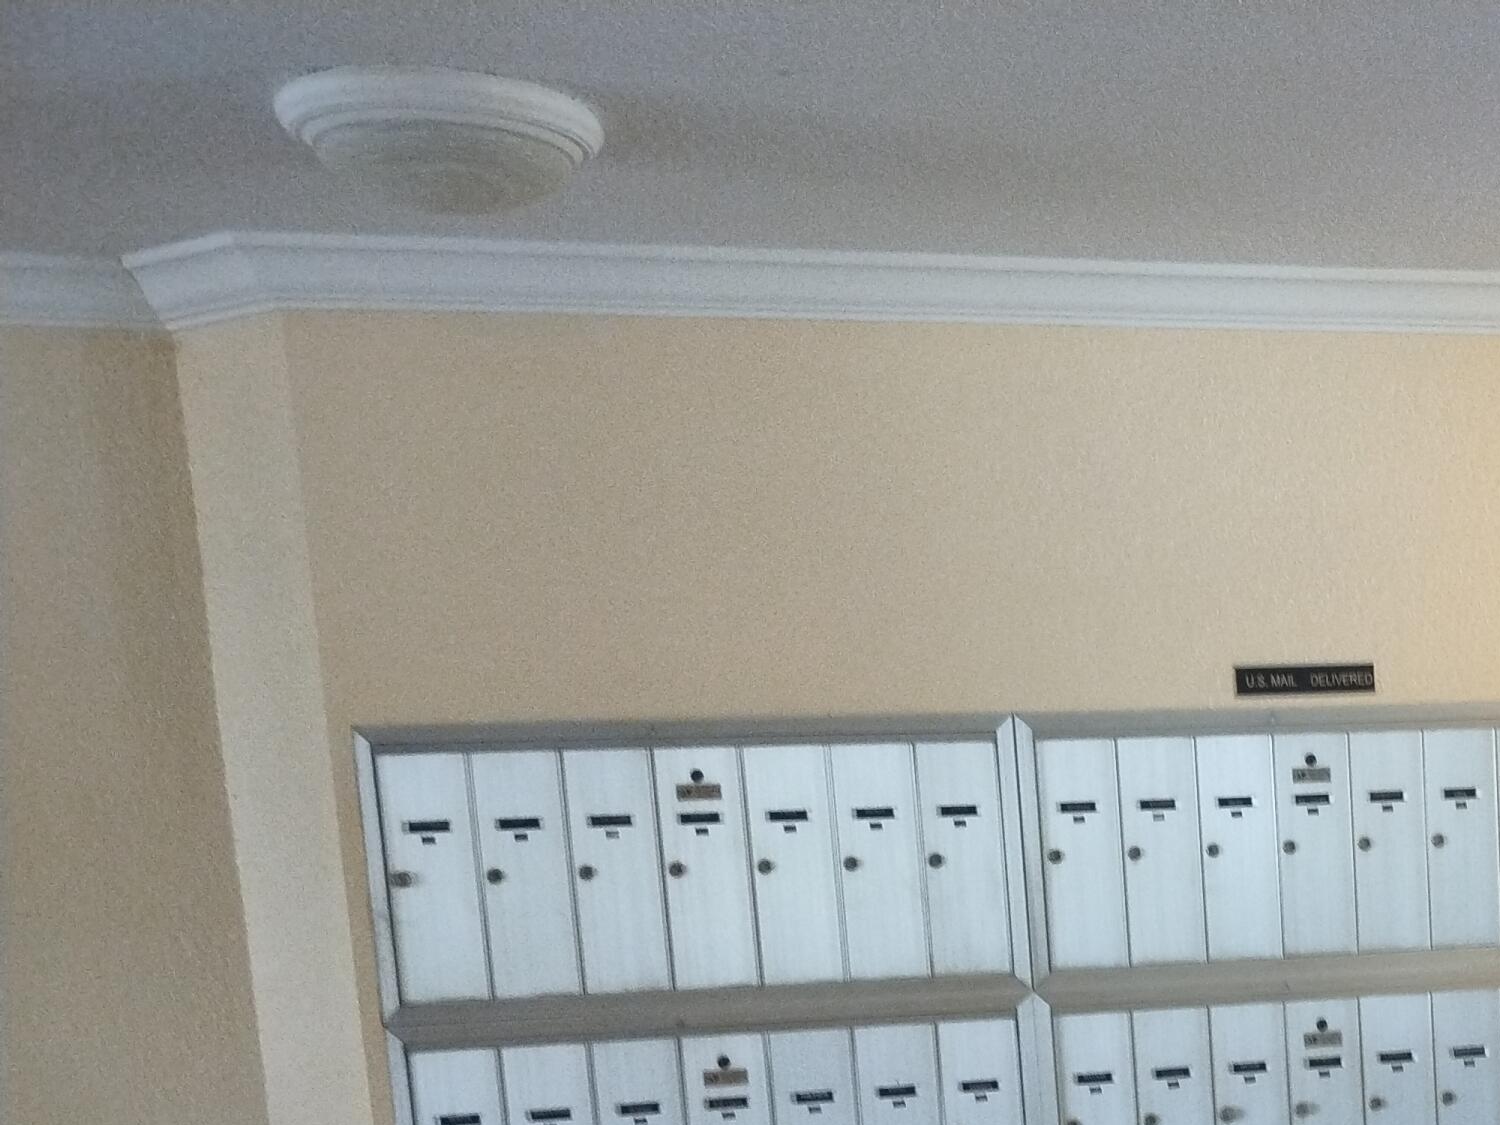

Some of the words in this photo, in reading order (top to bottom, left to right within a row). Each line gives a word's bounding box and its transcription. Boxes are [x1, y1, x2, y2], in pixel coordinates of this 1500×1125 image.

[1245, 673, 1268, 688] U.S.
[1270, 673, 1297, 688] MAIL
[1310, 671, 1373, 688] DELIVERED
